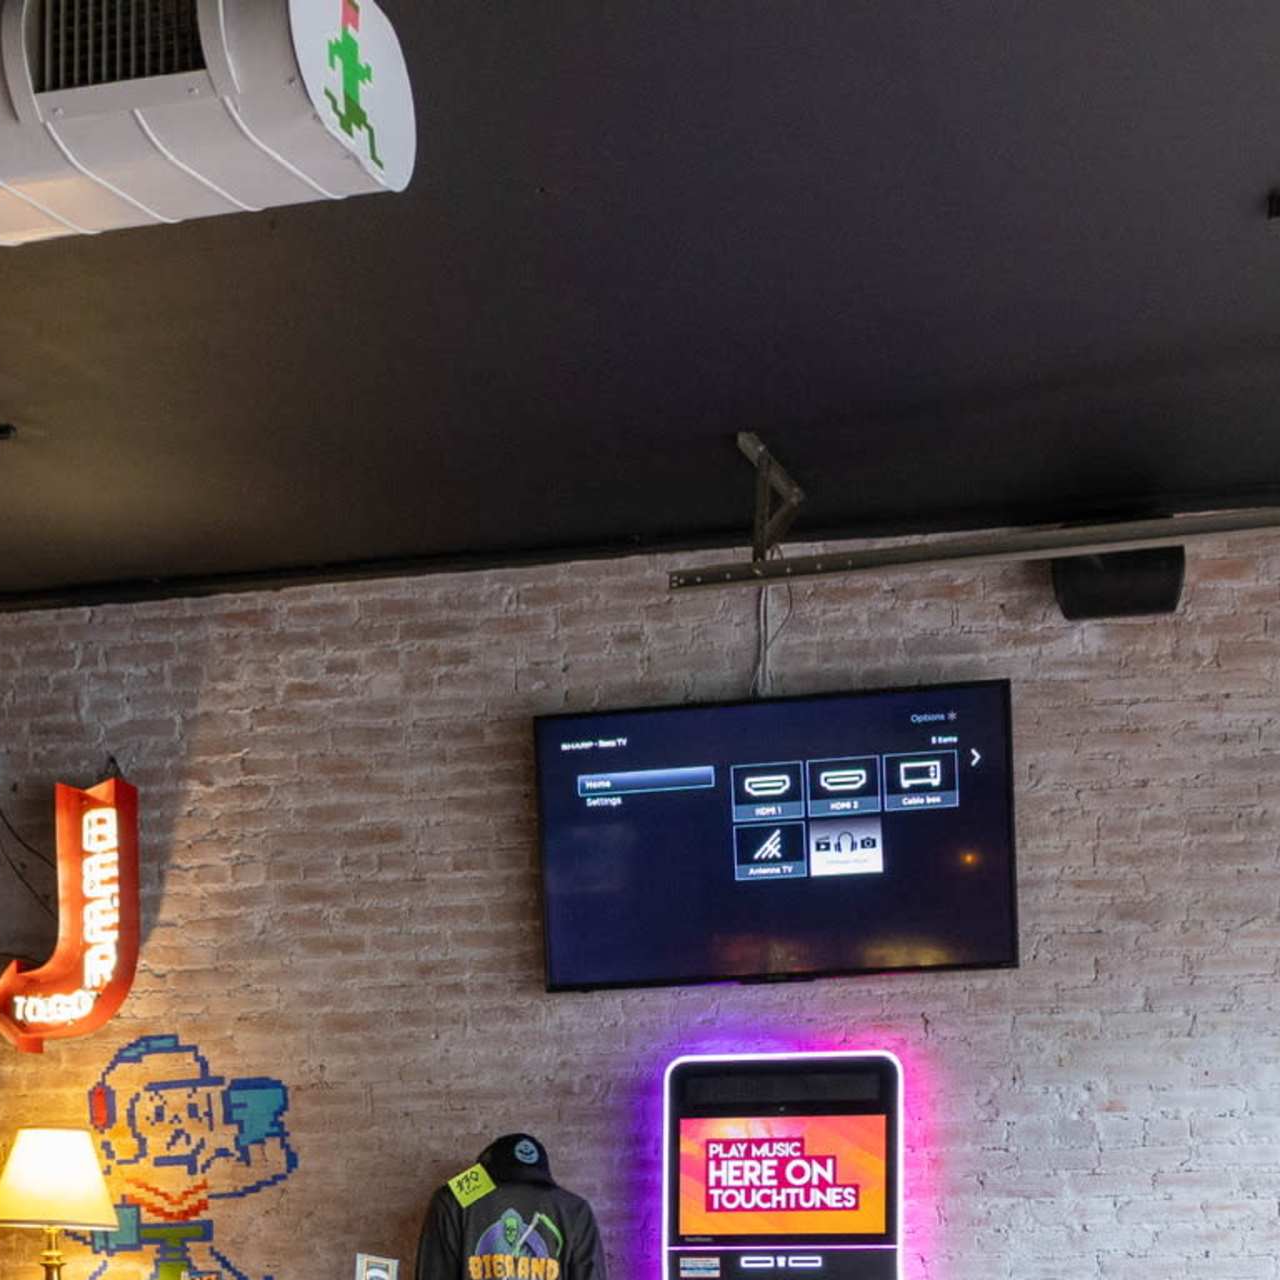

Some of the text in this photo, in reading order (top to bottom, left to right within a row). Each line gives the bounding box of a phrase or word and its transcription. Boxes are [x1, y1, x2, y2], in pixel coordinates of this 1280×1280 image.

[585, 779, 612, 790] Home
[586, 796, 623, 808] Settings
[781, 865, 793, 875] TV
[81, 807, 120, 989] BEER
[708, 1141, 801, 1158] PLAY MUSIC
[708, 1157, 834, 1187] HERE ON
[709, 1186, 857, 1210] TOUCHTUNES
